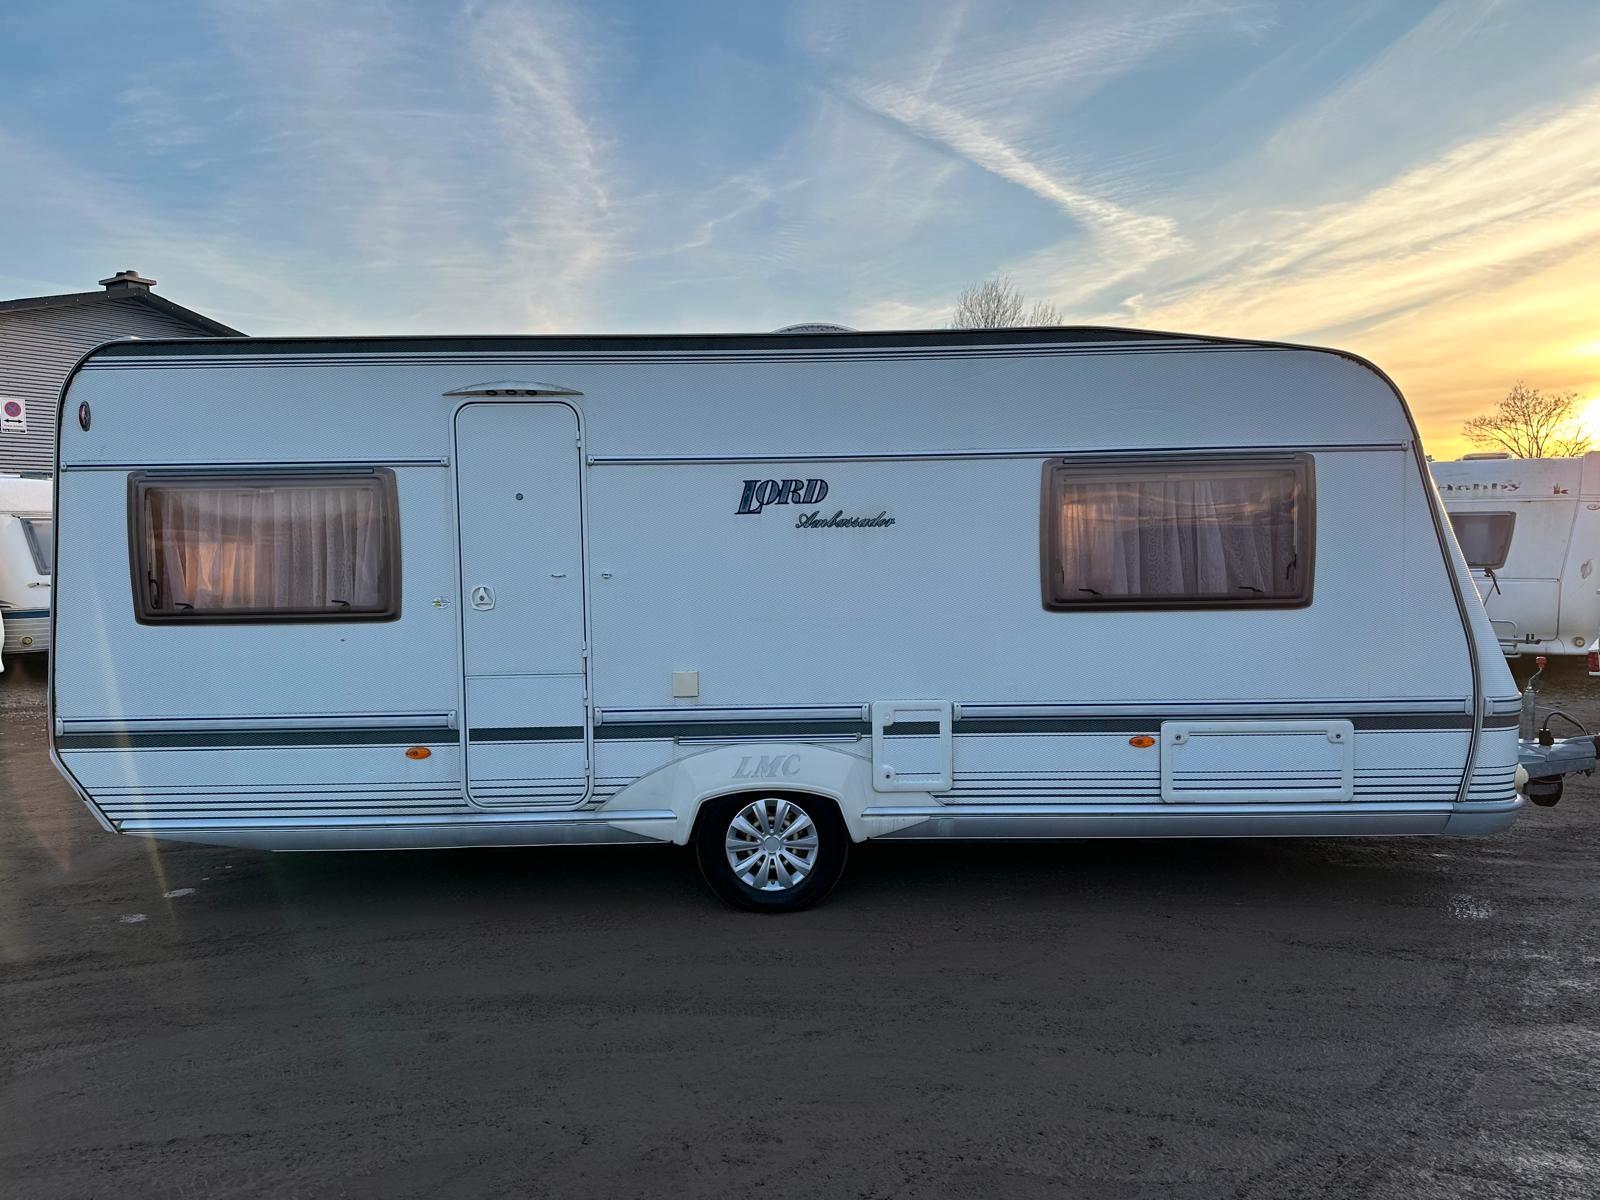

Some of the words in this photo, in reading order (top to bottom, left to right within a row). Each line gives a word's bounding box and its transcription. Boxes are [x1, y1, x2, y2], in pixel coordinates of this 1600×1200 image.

[734, 478, 829, 515] LORD
[795, 509, 896, 529] Ambassador
[731, 754, 801, 779] LMC
